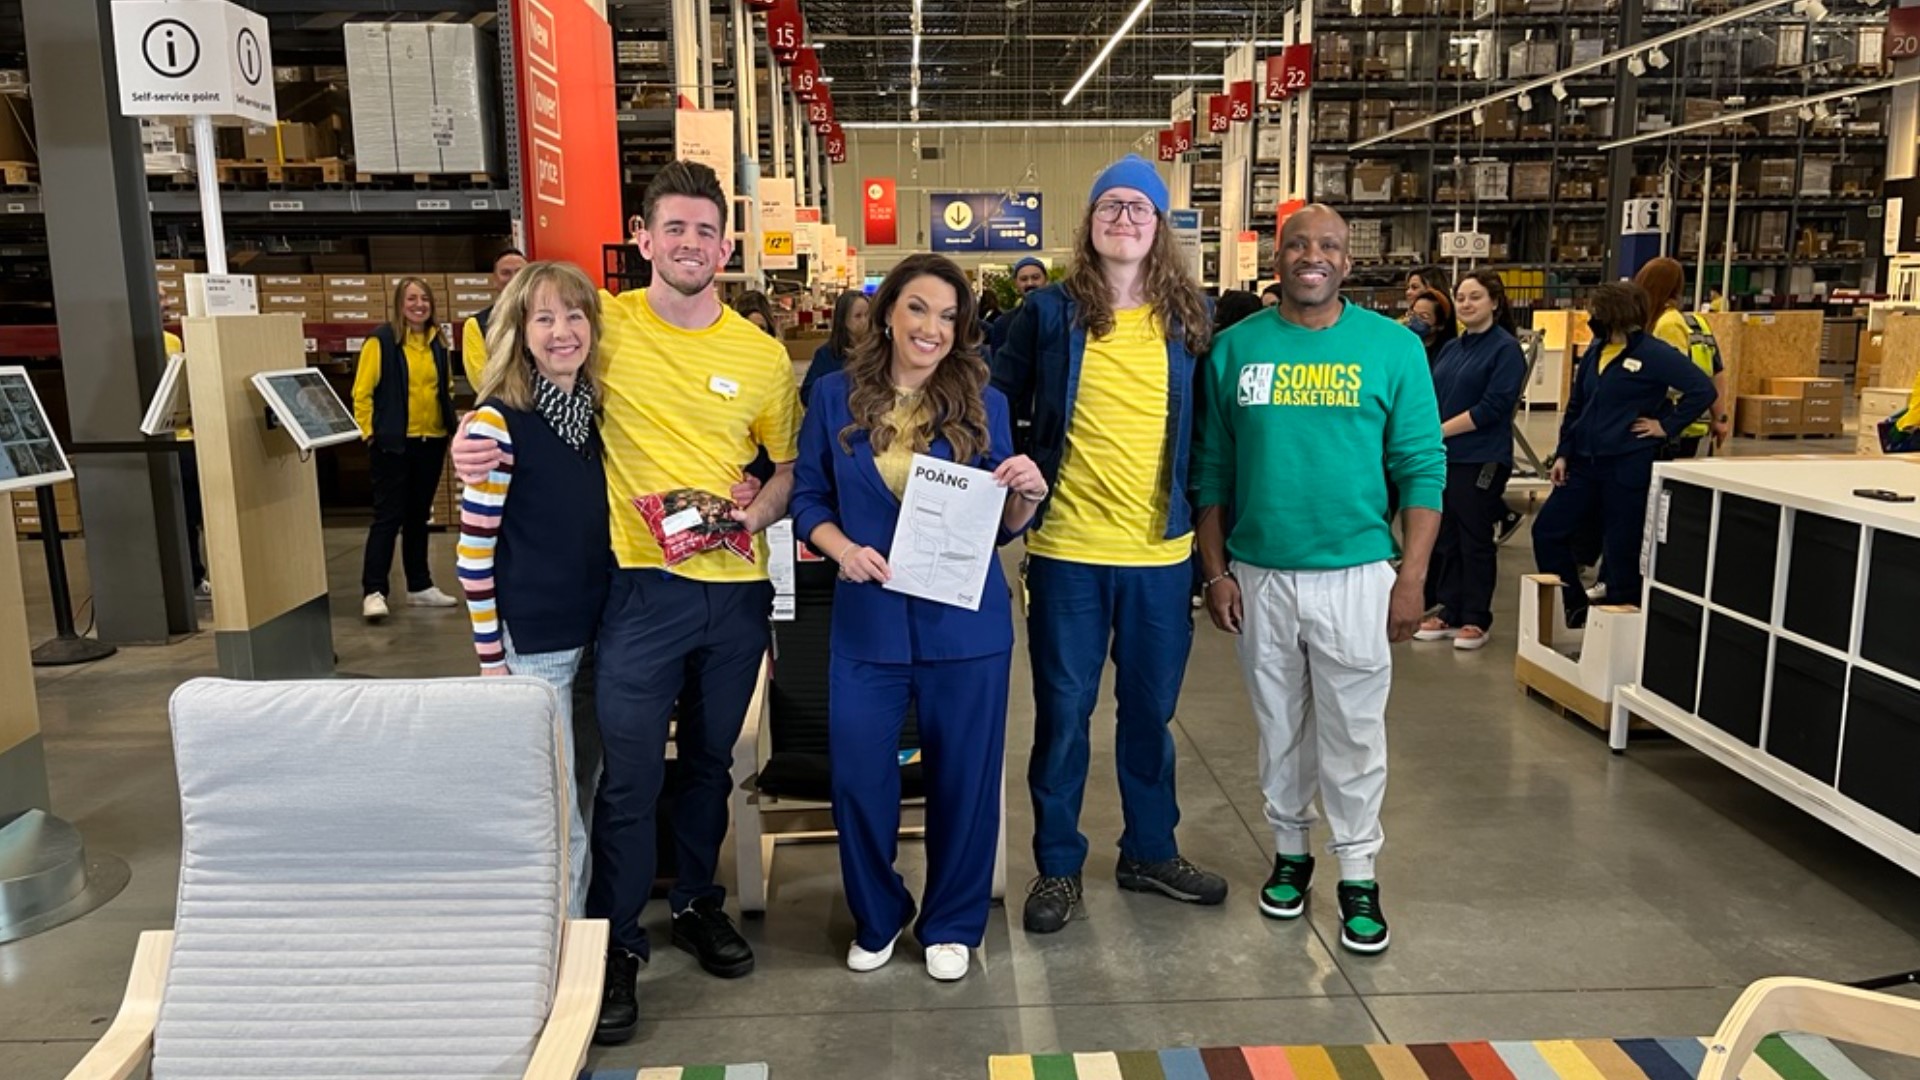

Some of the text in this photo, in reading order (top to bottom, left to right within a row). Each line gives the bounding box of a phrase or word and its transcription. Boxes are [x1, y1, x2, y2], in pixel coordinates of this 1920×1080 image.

[530, 11, 549, 49] New
[776, 27, 795, 48] 15
[1892, 37, 1918, 55] 20
[798, 74, 814, 91] 19
[1287, 71, 1306, 88] 22
[132, 91, 220, 104] Self-service point
[1270, 81, 1286, 98] 24
[534, 82, 556, 120] lower
[812, 107, 827, 122] 23
[1232, 103, 1248, 119] 26
[1212, 116, 1226, 129] 28
[829, 141, 841, 153] 27
[1161, 148, 1173, 160] 32
[1175, 139, 1188, 152] 30
[538, 154, 558, 188] price
[1274, 363, 1362, 390] SONICS
[1273, 389, 1360, 407] BASKETBALL
[915, 466, 969, 490] POÄNG
